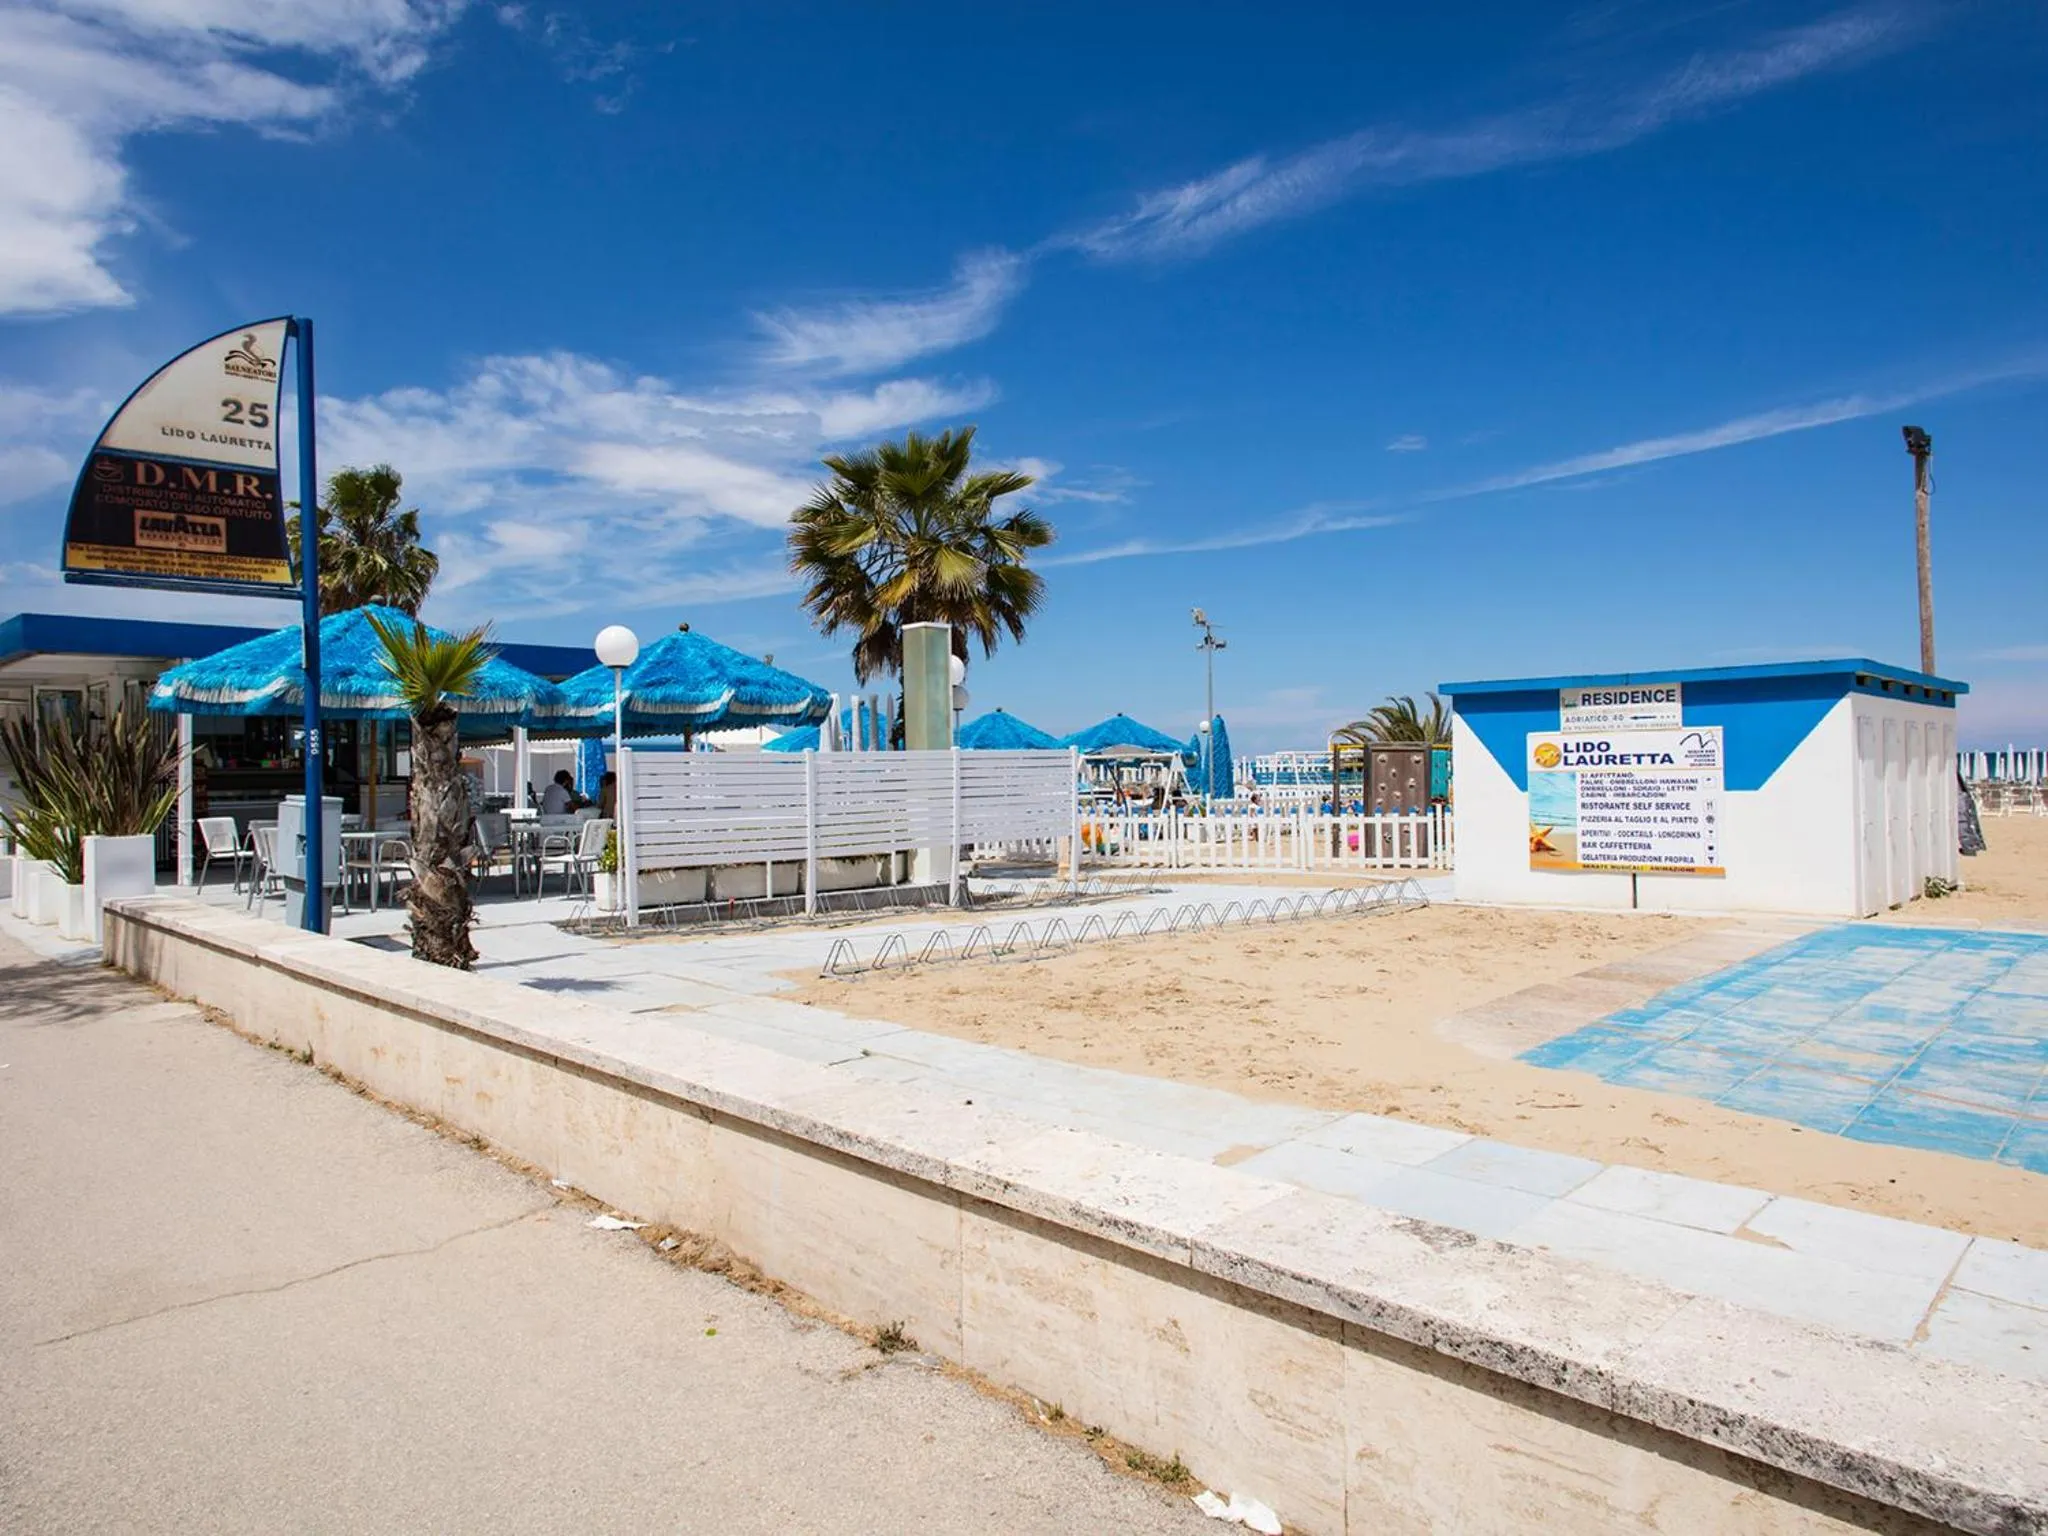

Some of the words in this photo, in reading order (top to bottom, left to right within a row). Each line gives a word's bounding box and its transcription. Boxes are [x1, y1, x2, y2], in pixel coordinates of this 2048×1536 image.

[221, 398, 270, 428] 25
[161, 426, 196, 440] LIDO
[201, 432, 272, 451] LAURETTA
[135, 461, 273, 500] D.M.R.
[102, 483, 192, 502] DISTRIBUTORI
[195, 493, 267, 510] AUTOMATICI
[212, 504, 273, 521] GRATUITO
[1581, 689, 1676, 706] RESIDENCE
[1563, 741, 1611, 753] LIDO
[1563, 753, 1674, 767] LAURETTA
[1580, 802, 1630, 811] RISTORANTE
[1633, 802, 1653, 811] SELF
[1655, 802, 1691, 811] SERVICE
[1580, 815, 1612, 823] PIZZERIA
[1660, 816, 1669, 824] AL
[1671, 816, 1699, 824] PIATTO
[1618, 830, 1653, 838] COCKTAILS
[1581, 841, 1598, 849] BAR
[1599, 841, 1652, 850] CAFFETTERIA
[1581, 853, 1618, 861] GELATERIA
[1619, 854, 1663, 862] PRODUZIONE
[1664, 855, 1695, 864] PROPRIA
